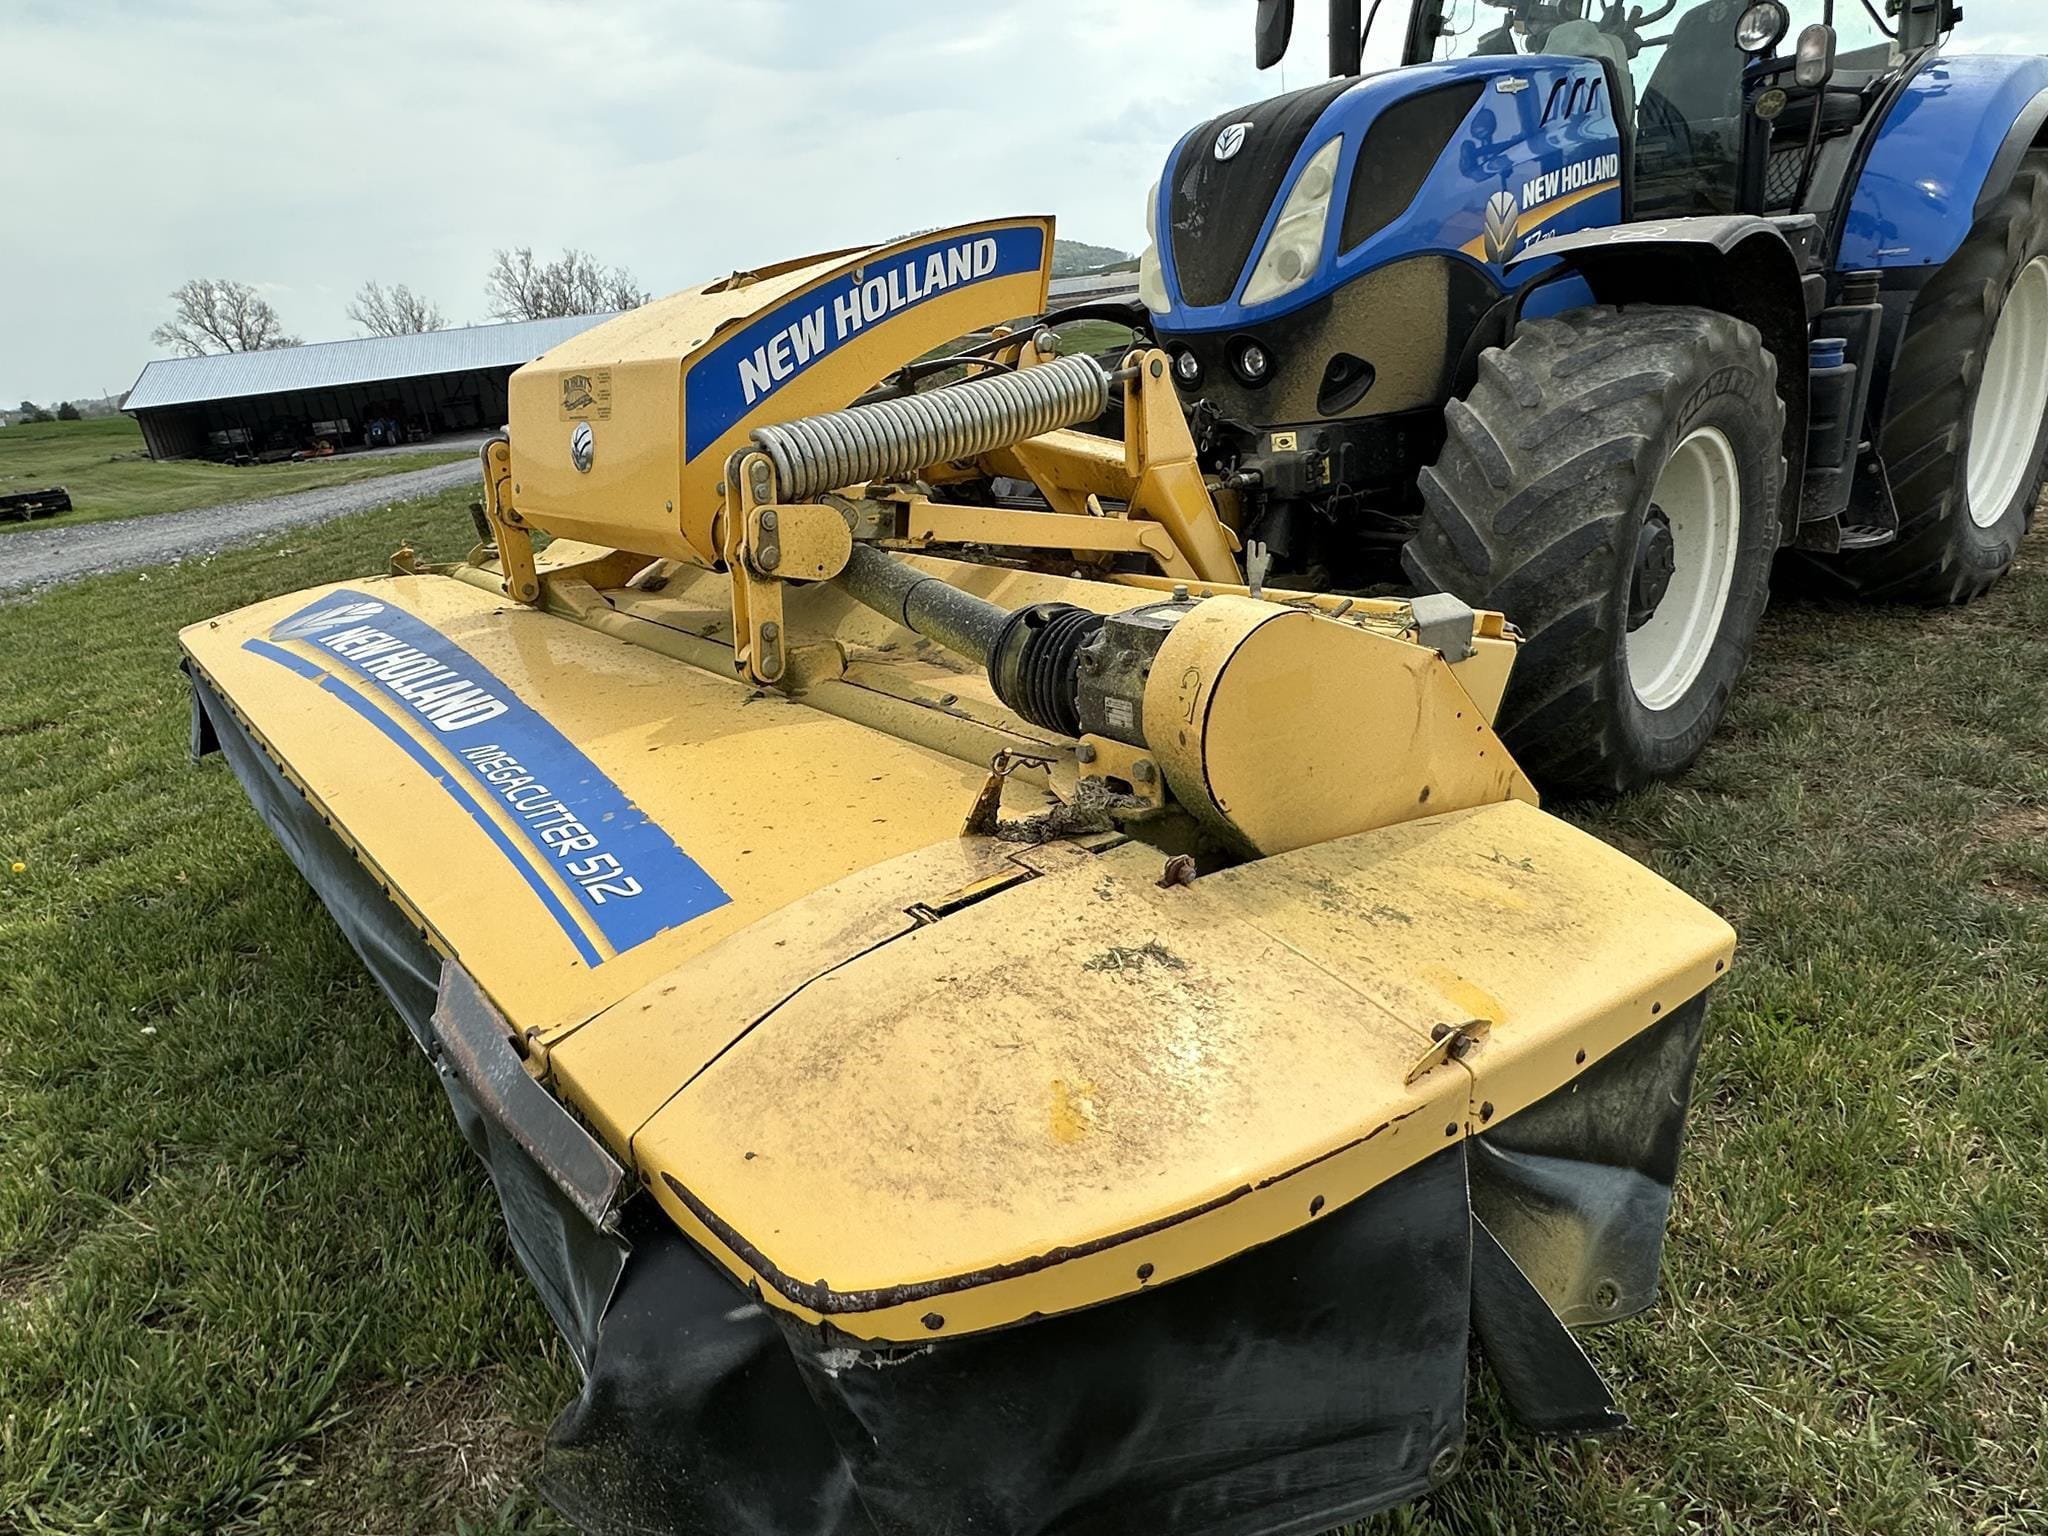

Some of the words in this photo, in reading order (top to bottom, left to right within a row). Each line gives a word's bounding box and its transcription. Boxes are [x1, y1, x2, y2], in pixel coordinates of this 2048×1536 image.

[1522, 169, 1560, 210] NEW
[1561, 153, 1618, 193] HOLLAND
[737, 306, 825, 405] NEW
[833, 237, 997, 340] HOLLAND
[318, 624, 410, 662] NEW
[360, 648, 509, 732] HOLLAND
[460, 744, 599, 858] MEGACUTTER
[566, 852, 643, 905] 512
